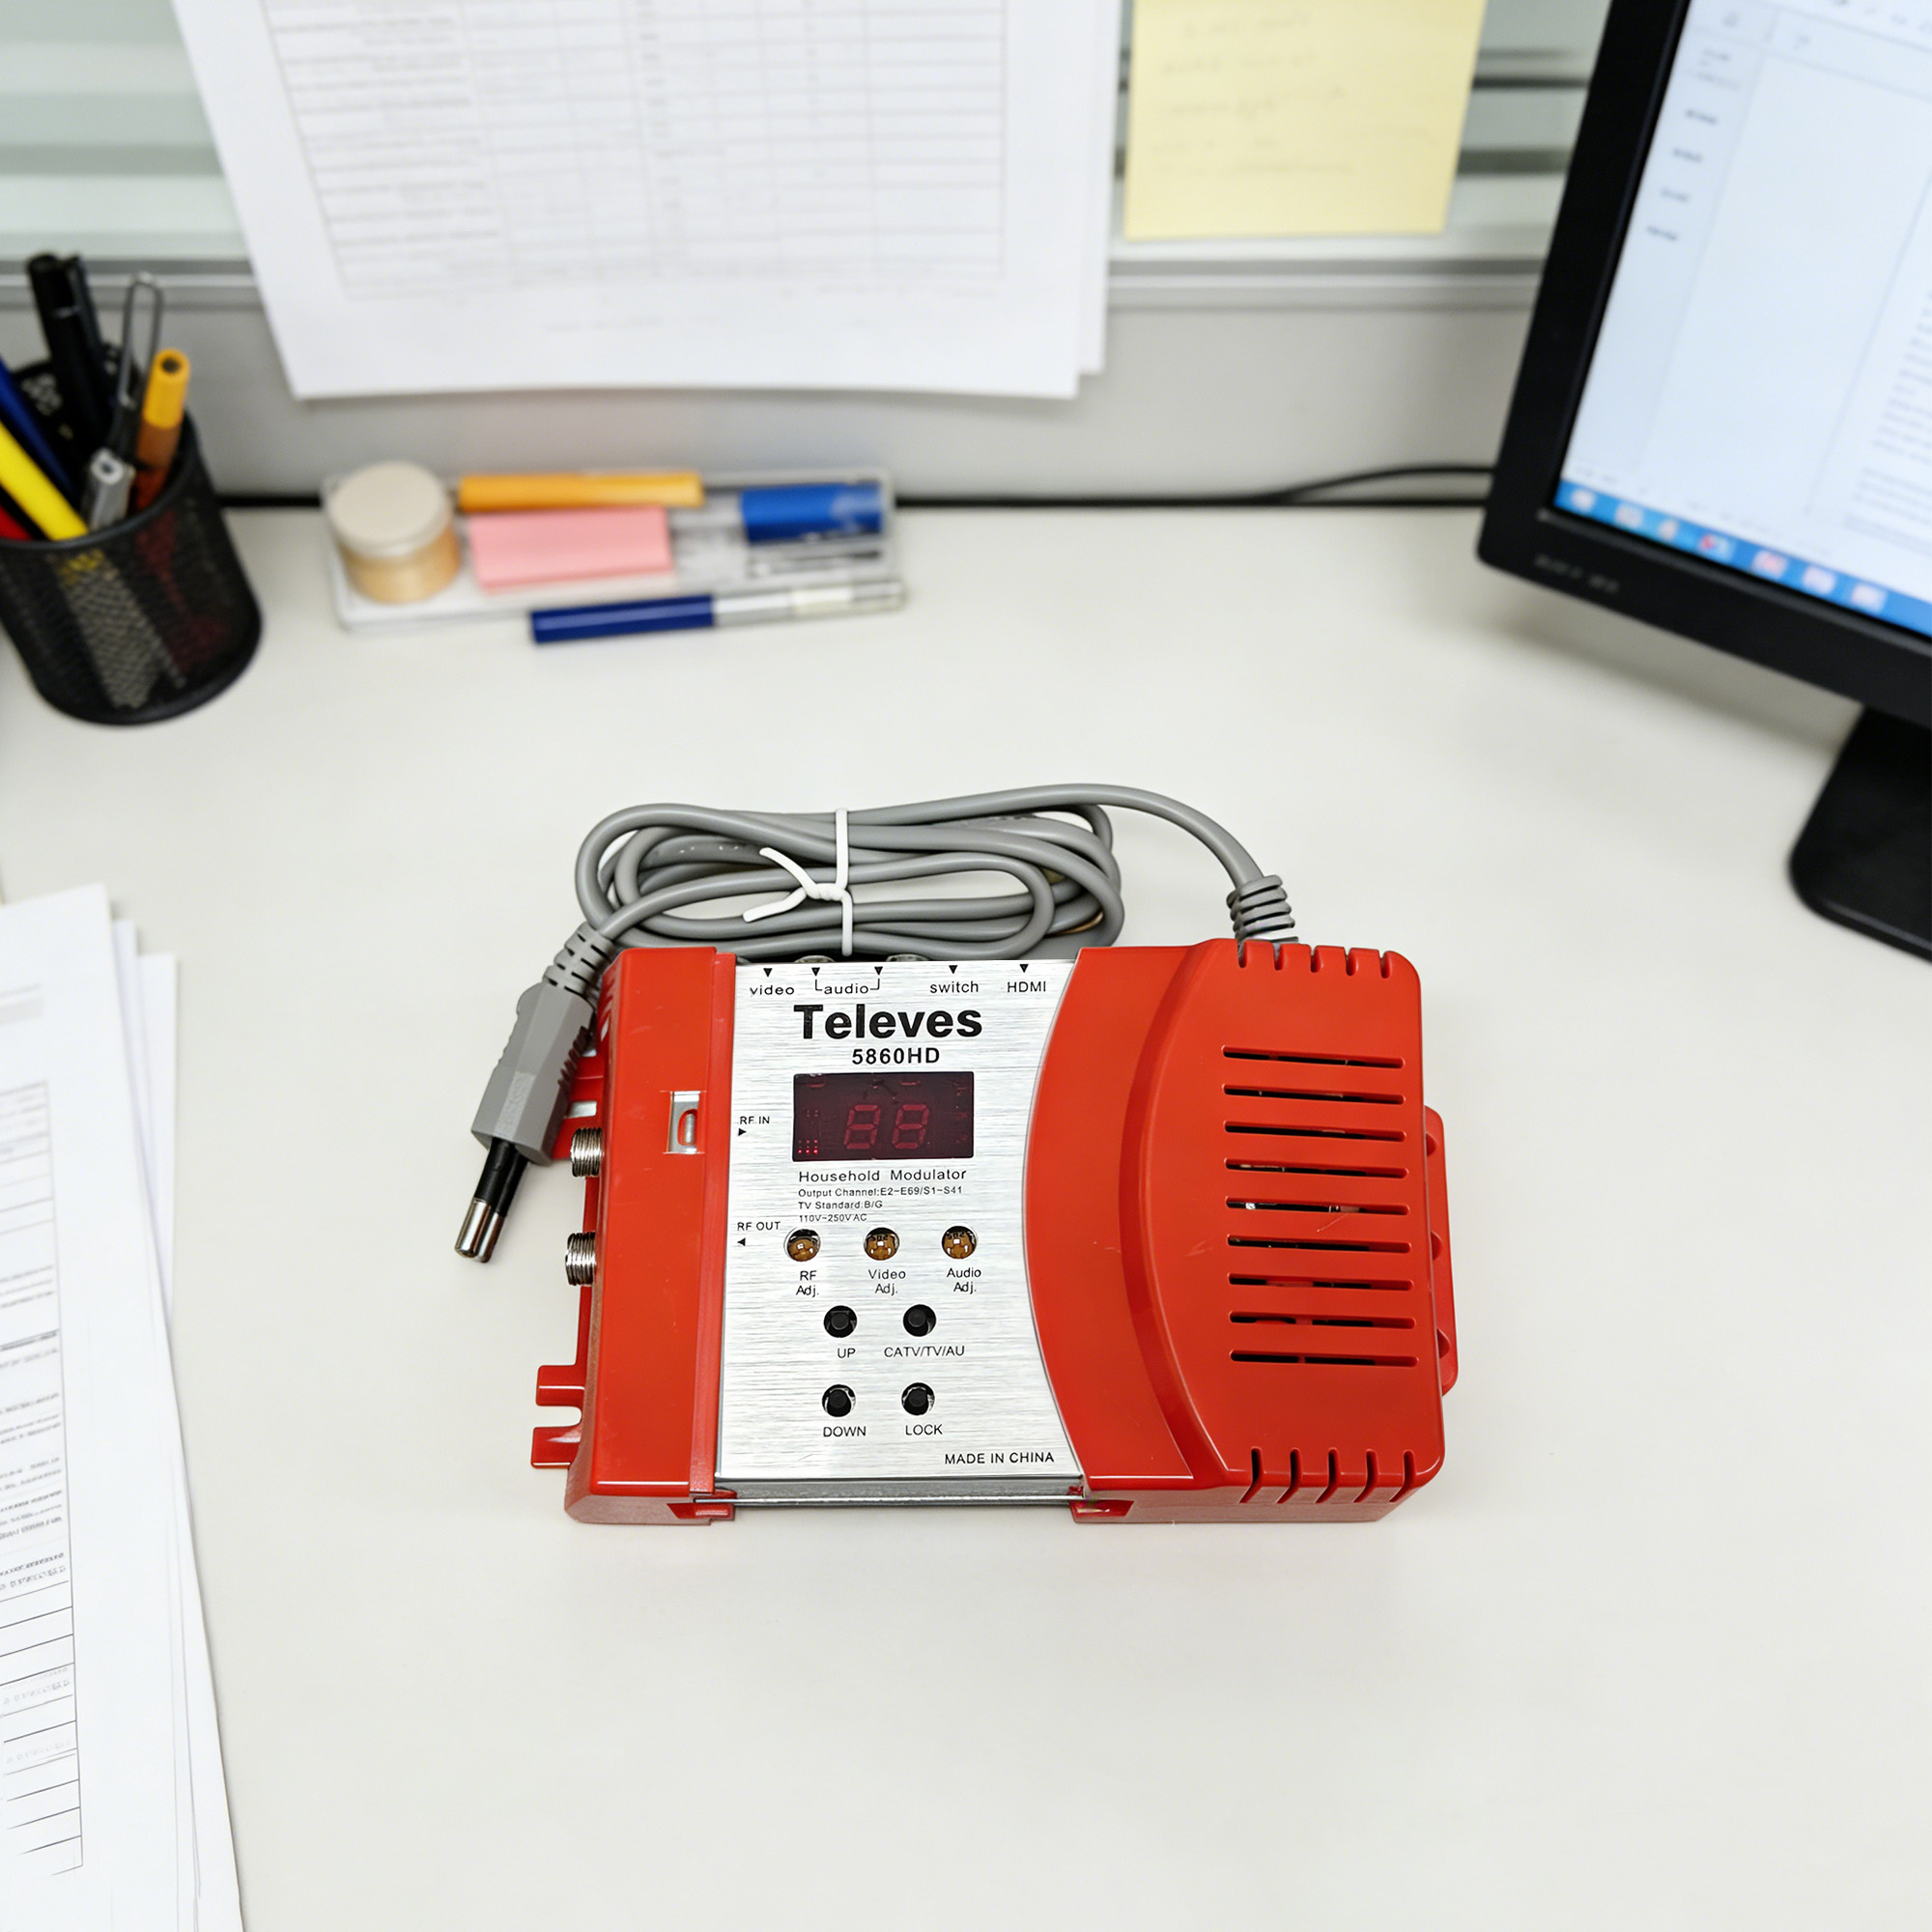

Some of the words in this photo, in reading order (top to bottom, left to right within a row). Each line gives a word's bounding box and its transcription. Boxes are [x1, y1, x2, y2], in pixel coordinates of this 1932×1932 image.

[749, 984, 795, 996] video
[824, 982, 869, 995] audio
[929, 980, 979, 994] switch
[1007, 980, 1046, 993] HDMI
[793, 1004, 982, 1040] Televes
[851, 1047, 940, 1065] 5860HD
[739, 1116, 754, 1125] RF
[758, 1116, 770, 1125] IN
[799, 1170, 880, 1182] Household
[890, 1169, 967, 1181] Modulator
[798, 1188, 832, 1199] Output
[798, 1201, 811, 1209] TV
[737, 1221, 753, 1232] RF
[755, 1220, 781, 1232] OUT
[799, 1270, 817, 1281] RF
[867, 1268, 906, 1280] Video
[946, 1266, 982, 1279] Audio
[796, 1285, 819, 1297] Adj.
[875, 1283, 898, 1296] Adj.
[952, 1281, 977, 1295] Adj.
[837, 1348, 856, 1359] UP
[883, 1345, 965, 1358] CATV/TV/AU
[822, 1426, 867, 1437] DOWN
[905, 1424, 943, 1436] LOCK
[945, 1453, 985, 1464] MADE
[990, 1452, 1005, 1463] IN
[1009, 1451, 1055, 1463] CHINA
